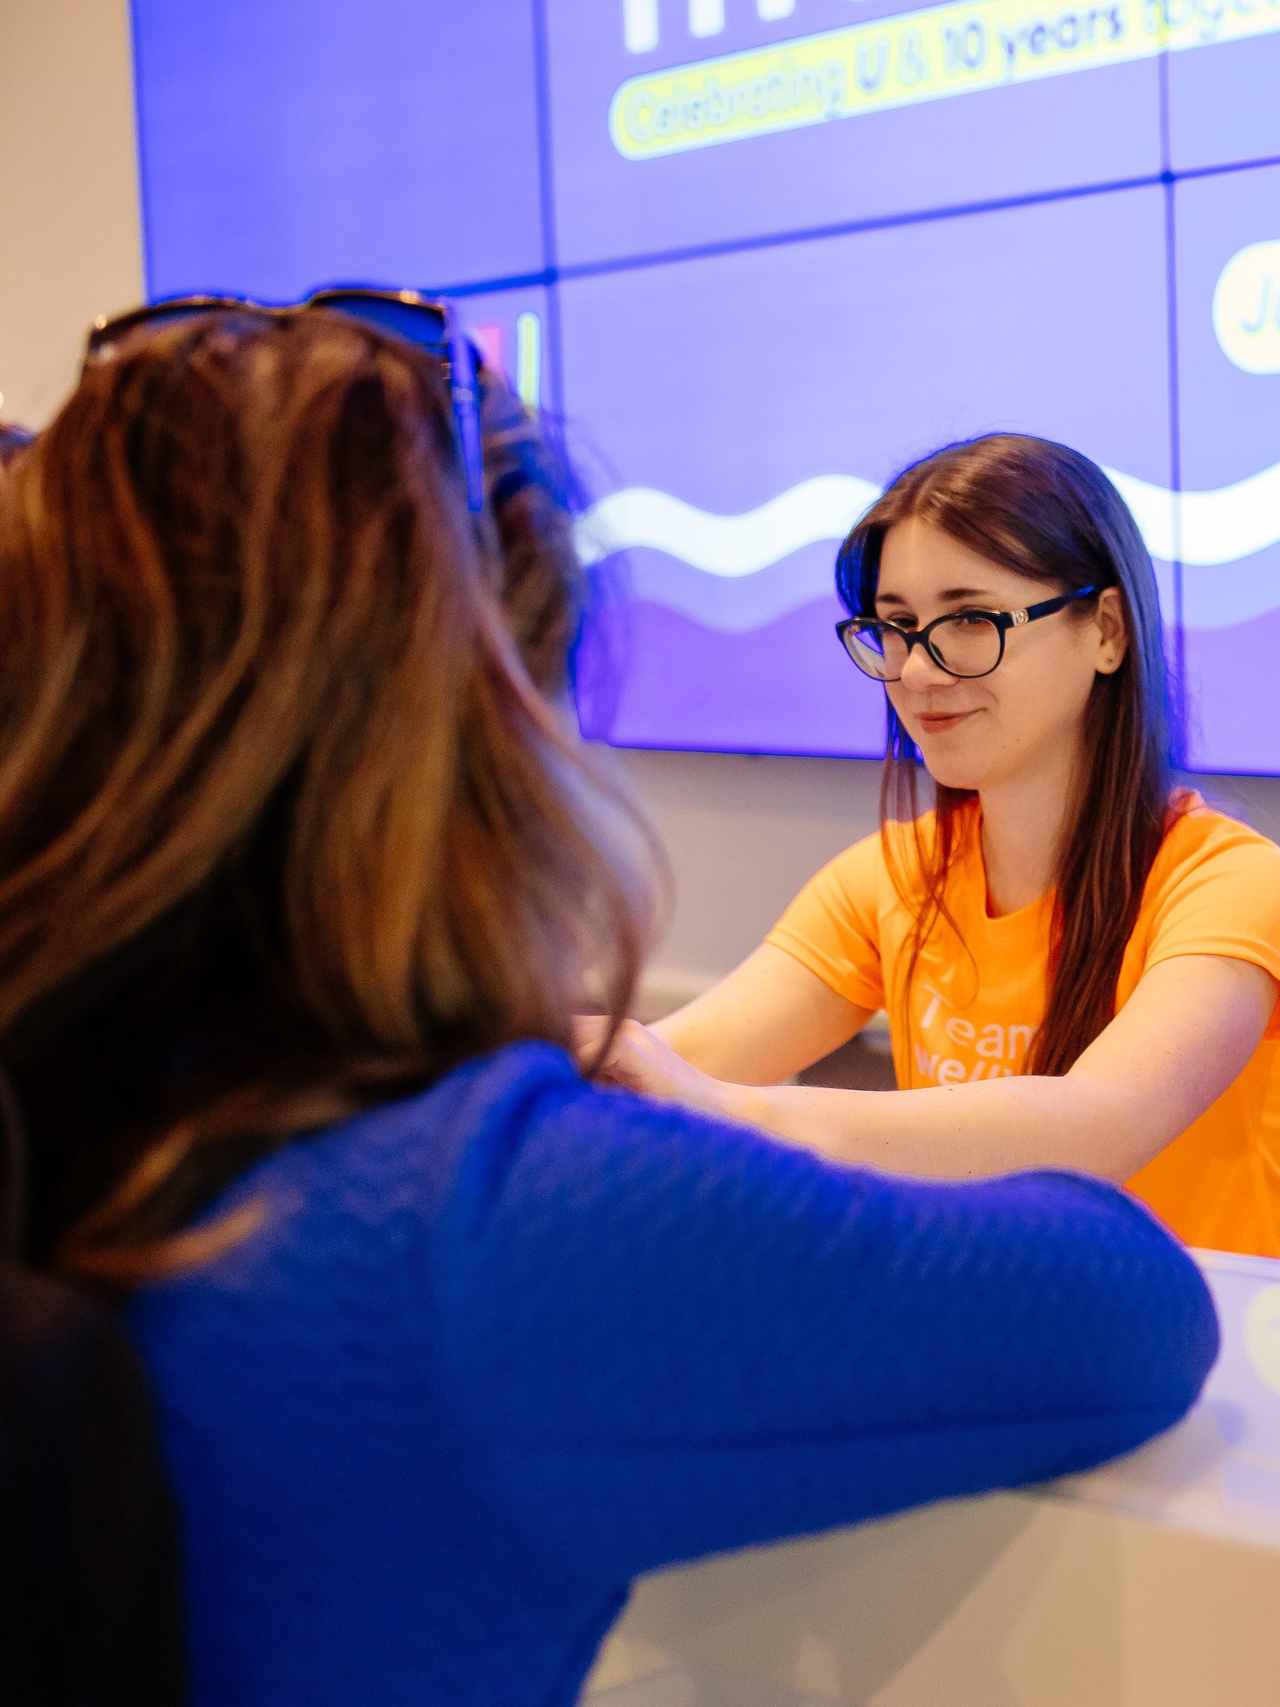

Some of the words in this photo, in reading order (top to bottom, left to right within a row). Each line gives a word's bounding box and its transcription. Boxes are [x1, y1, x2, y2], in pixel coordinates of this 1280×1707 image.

[854, 38, 891, 94] U
[897, 29, 931, 86] &
[940, 17, 989, 75] 10
[999, 7, 1124, 83] years
[921, 983, 1039, 1060] Team
